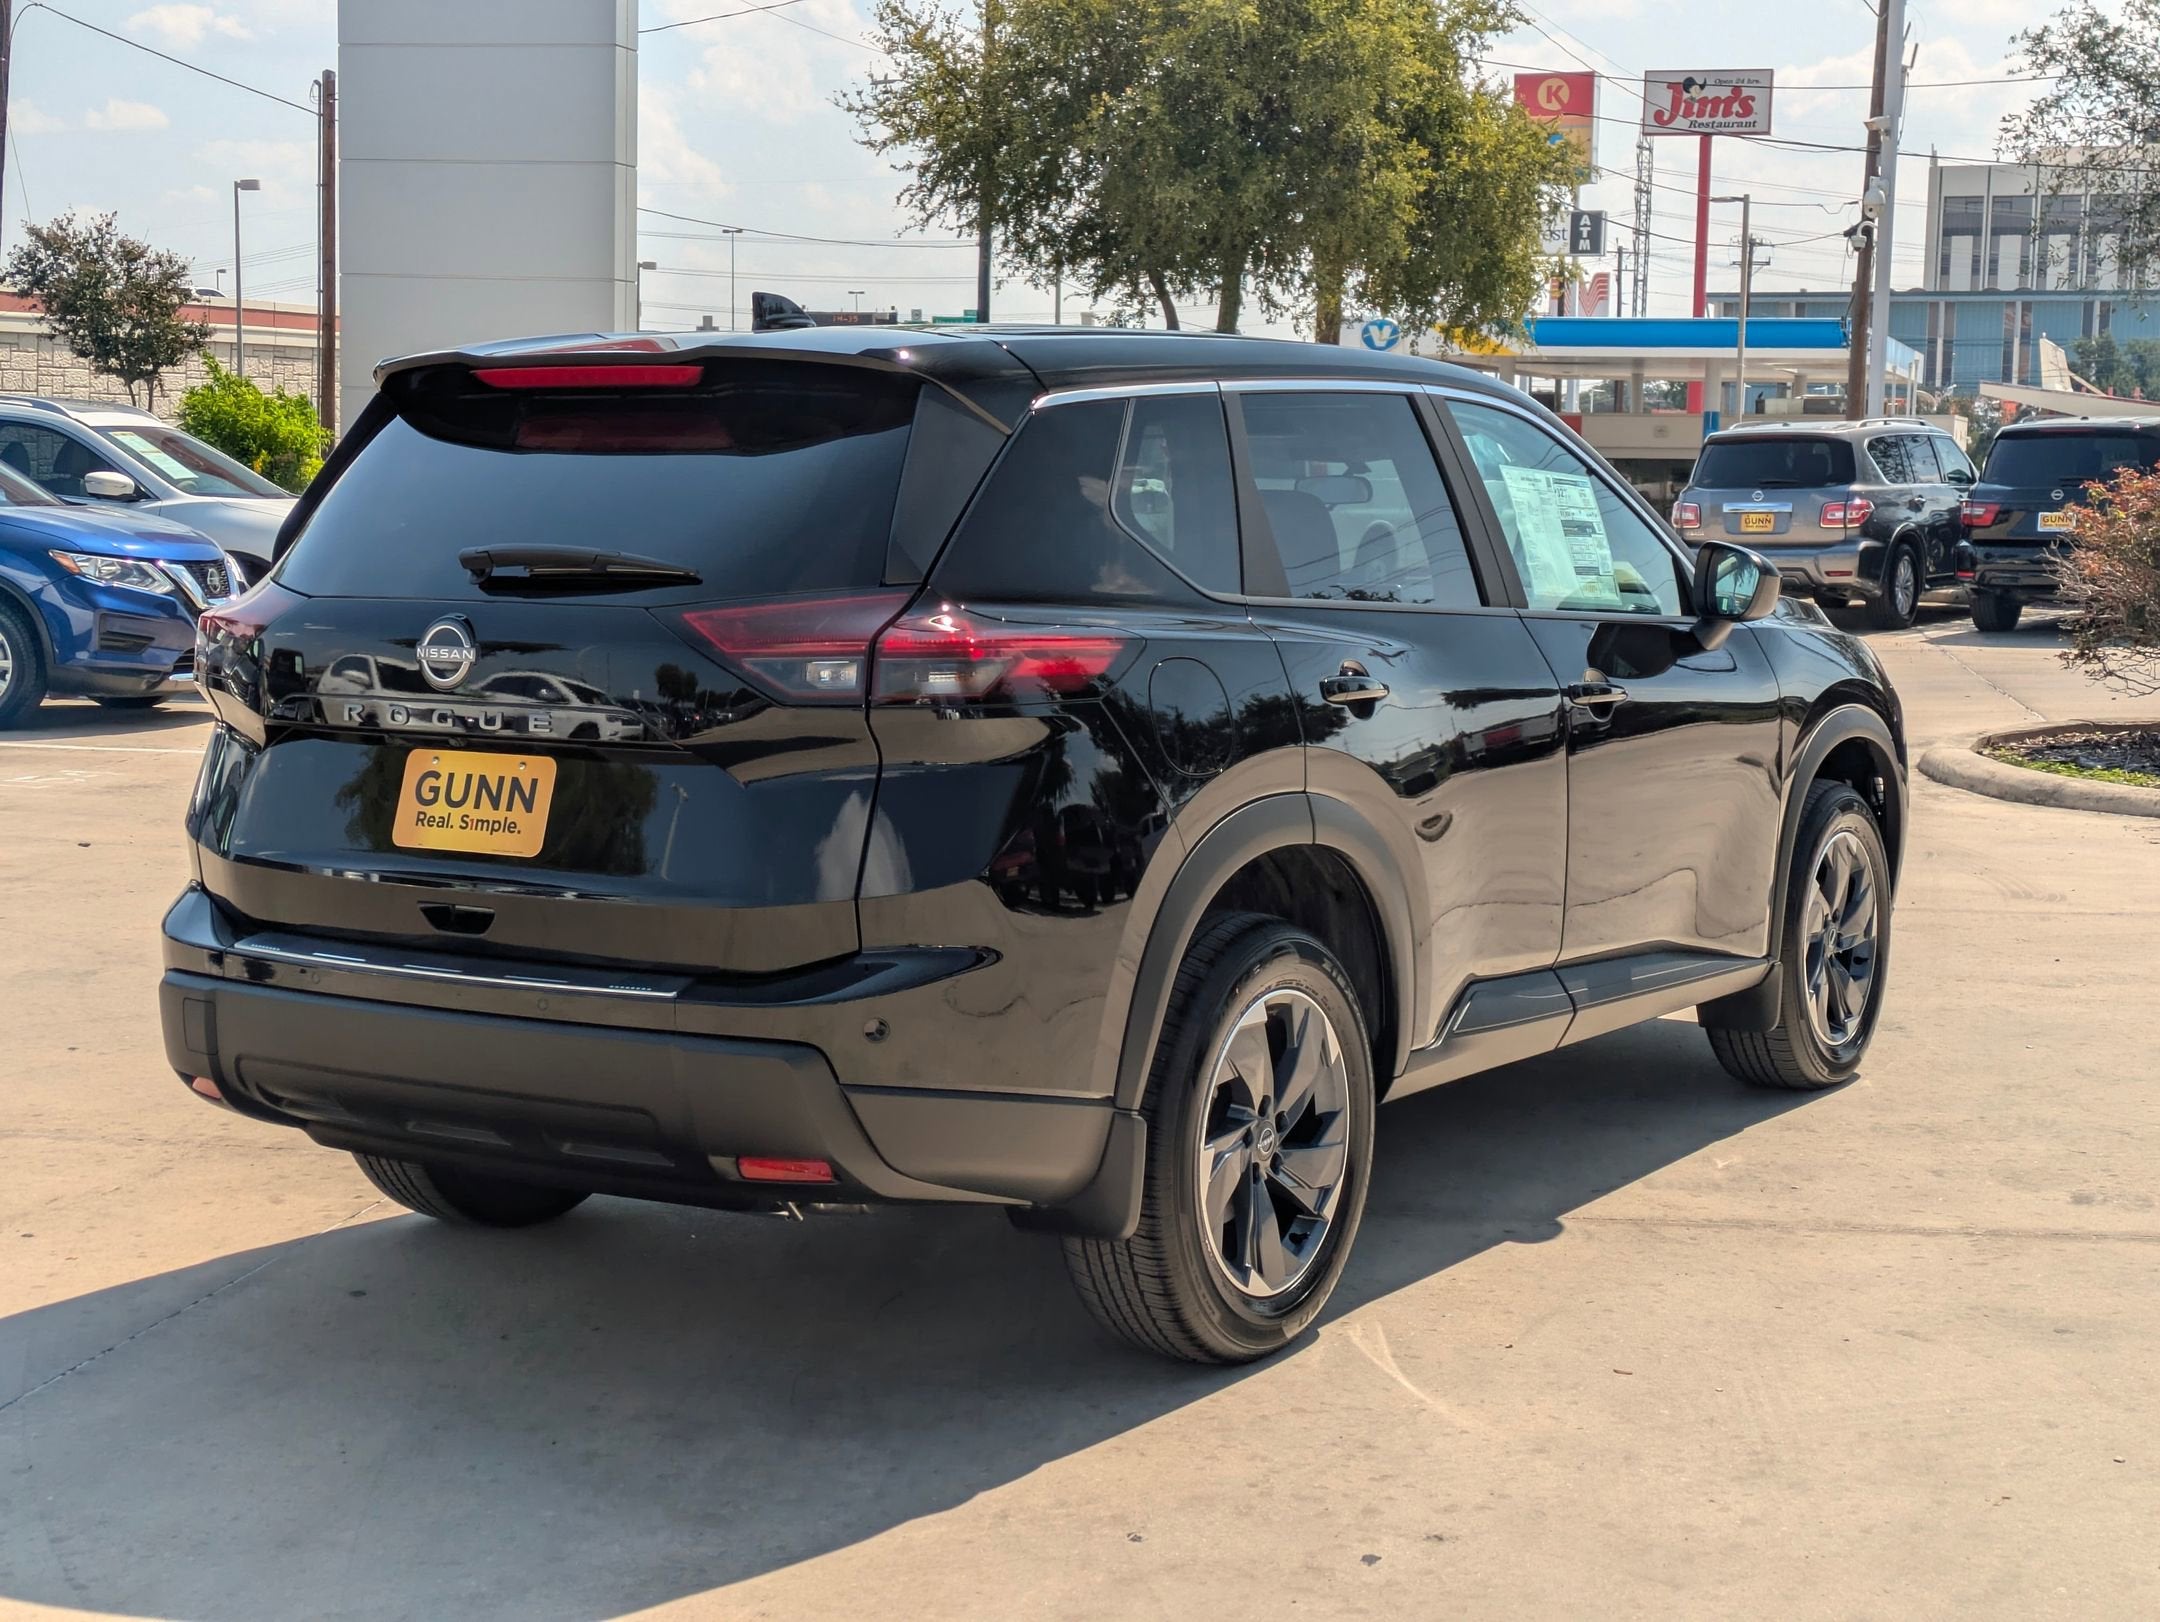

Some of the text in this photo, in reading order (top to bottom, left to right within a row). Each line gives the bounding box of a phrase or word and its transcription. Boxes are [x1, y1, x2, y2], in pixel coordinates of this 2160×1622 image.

[1546, 84, 1567, 108] K
[1654, 82, 1756, 126] Jim's
[1688, 120, 1758, 129] Restaurant
[1579, 214, 1591, 251] ATM
[1744, 517, 1771, 525] GUNN
[416, 647, 474, 660] NISSAN
[343, 703, 553, 733] ROGUE
[415, 770, 539, 813] GUNN
[415, 811, 454, 829] Real.
